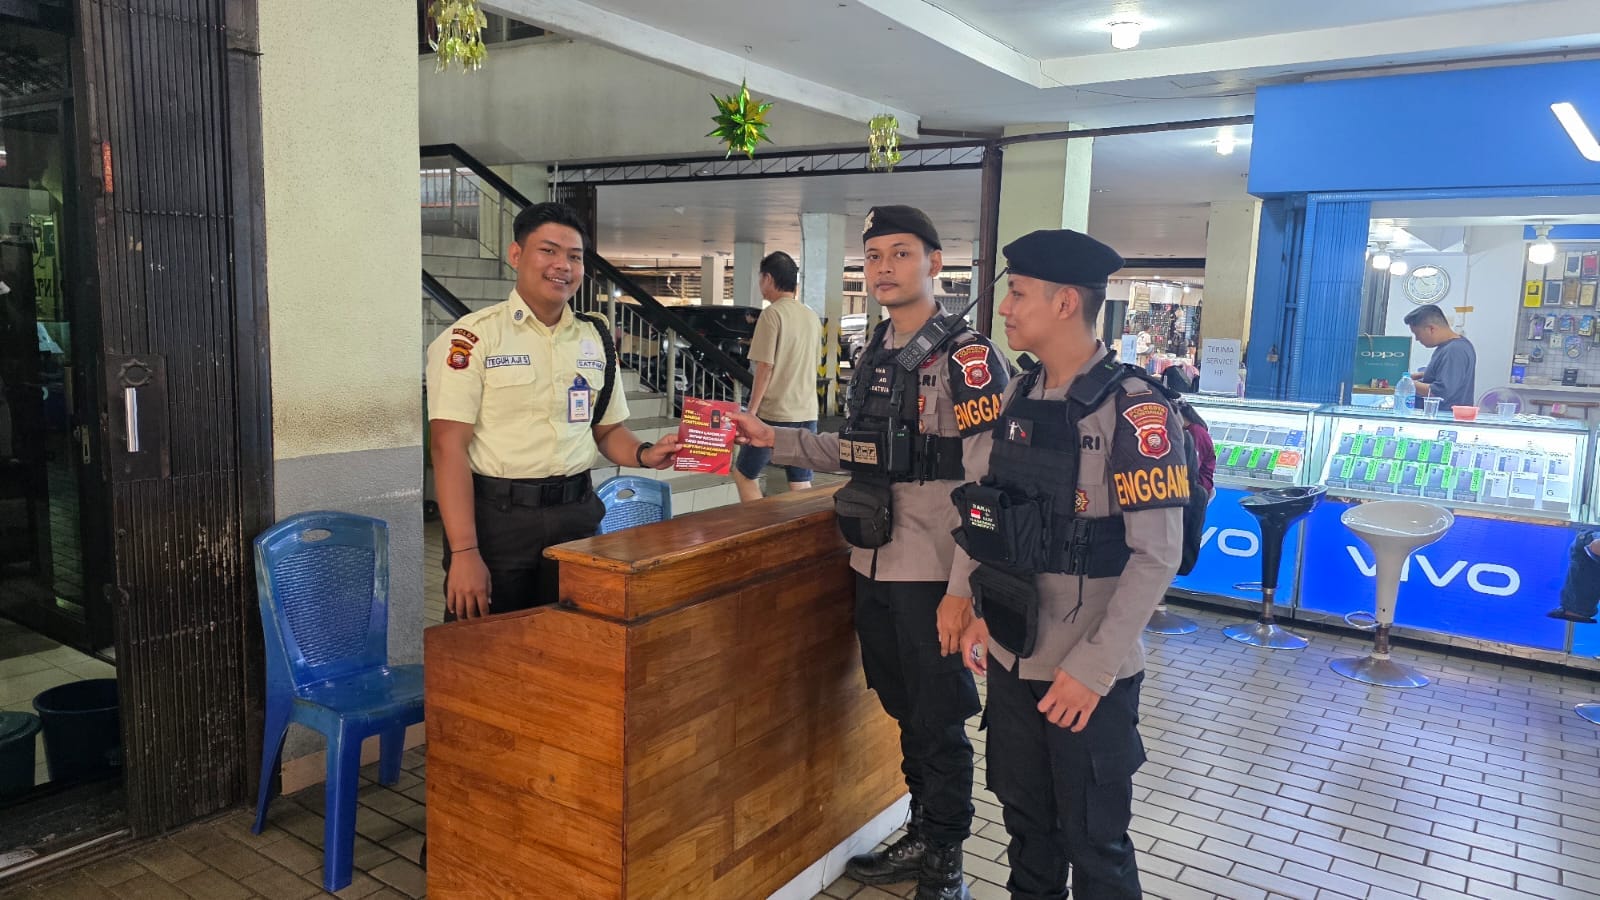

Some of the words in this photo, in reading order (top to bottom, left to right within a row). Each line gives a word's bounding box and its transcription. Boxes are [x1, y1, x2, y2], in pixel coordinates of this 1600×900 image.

[454, 329, 476, 342] POLDA
[1207, 345, 1234, 353] TERIMA
[488, 357, 509, 367] TEGUH
[1205, 357, 1234, 366] SERVICE
[919, 374, 937, 387] RI
[953, 393, 1003, 431] ENGGA
[1080, 435, 1101, 451] RI
